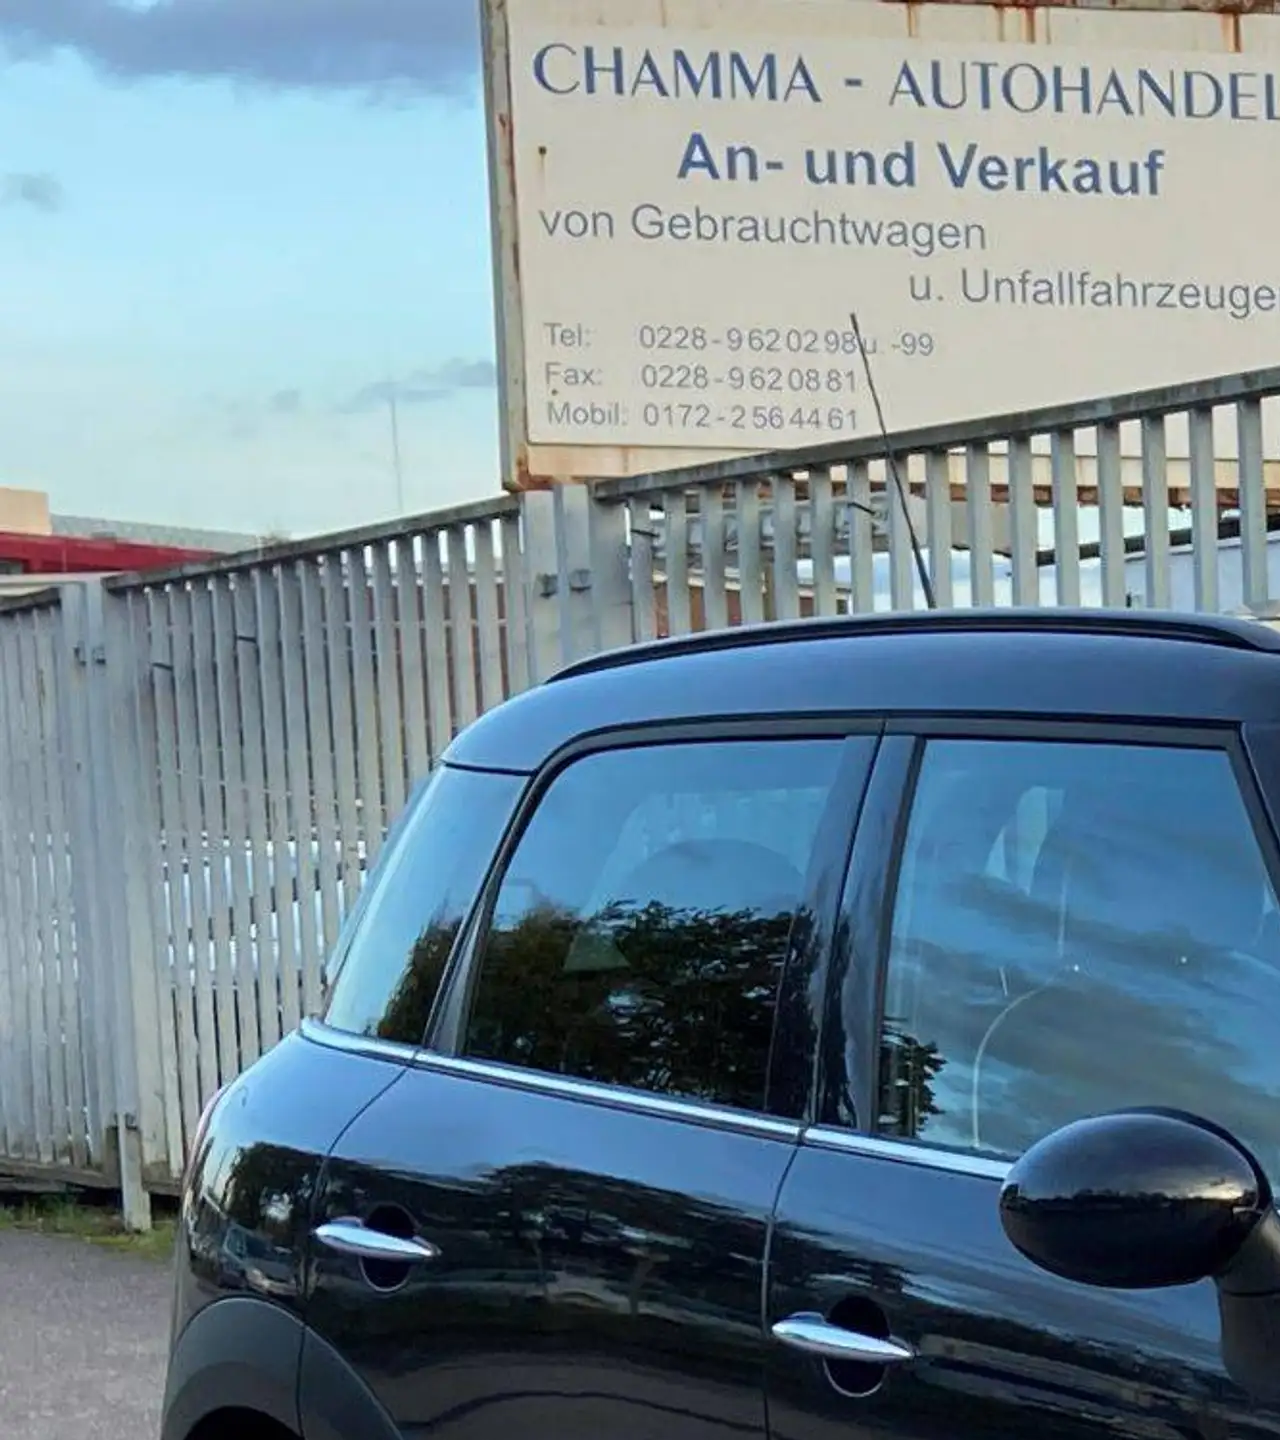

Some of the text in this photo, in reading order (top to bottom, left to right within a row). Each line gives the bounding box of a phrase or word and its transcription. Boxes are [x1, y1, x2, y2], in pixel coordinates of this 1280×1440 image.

[533, 43, 822, 102] CHAMMA
[677, 131, 1165, 196] An- und Verkauf
[539, 203, 987, 257] von Gebrauchtwagen
[909, 274, 944, 301] u.
[543, 322, 592, 348] Tel:
[891, 331, 934, 357] -99
[545, 361, 604, 387] Fax:
[547, 401, 628, 427] Mobil:
